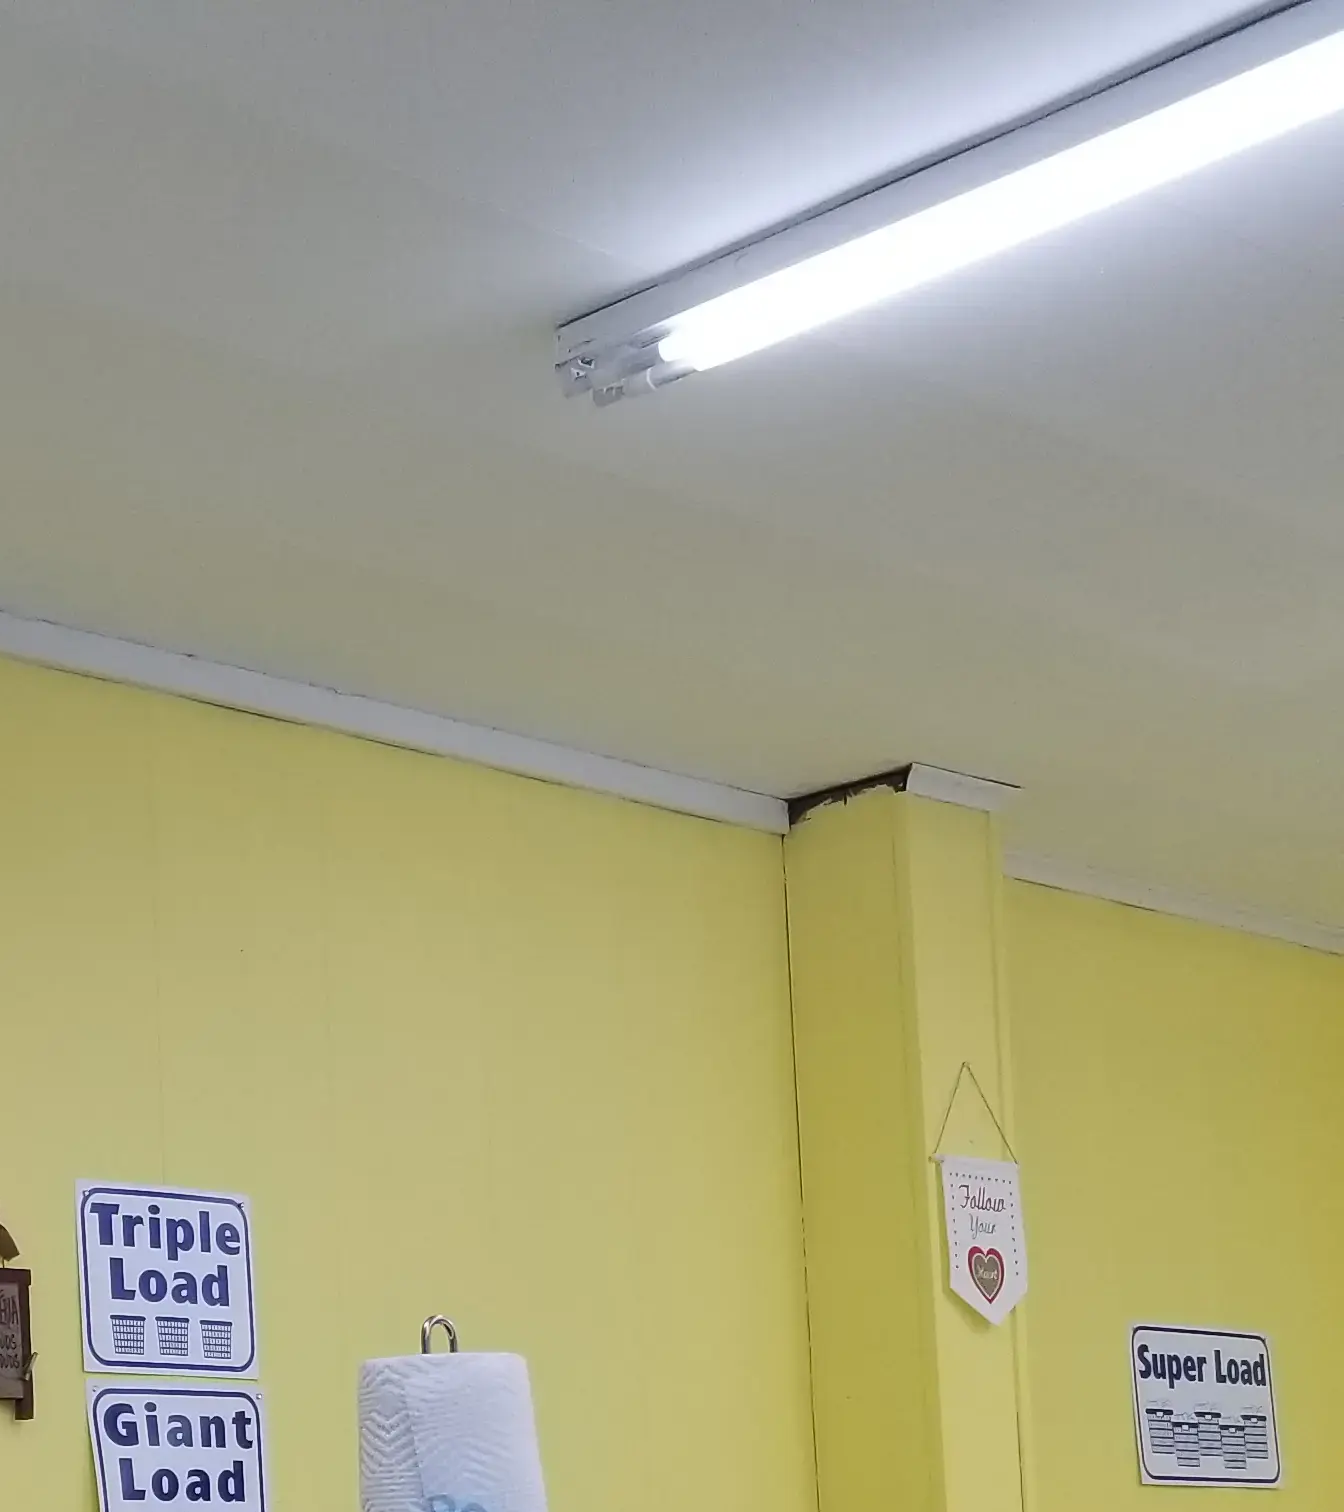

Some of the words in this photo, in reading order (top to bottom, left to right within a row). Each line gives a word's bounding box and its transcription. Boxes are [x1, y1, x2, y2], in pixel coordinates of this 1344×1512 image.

[959, 1184, 1006, 1212] Follow
[89, 1202, 241, 1261] Triple
[969, 1213, 996, 1239] Your
[109, 1256, 230, 1307] Load
[1137, 1343, 1207, 1389] Super
[1213, 1349, 1267, 1387] Load
[103, 1402, 254, 1450] Giant
[119, 1457, 246, 1503] Load
